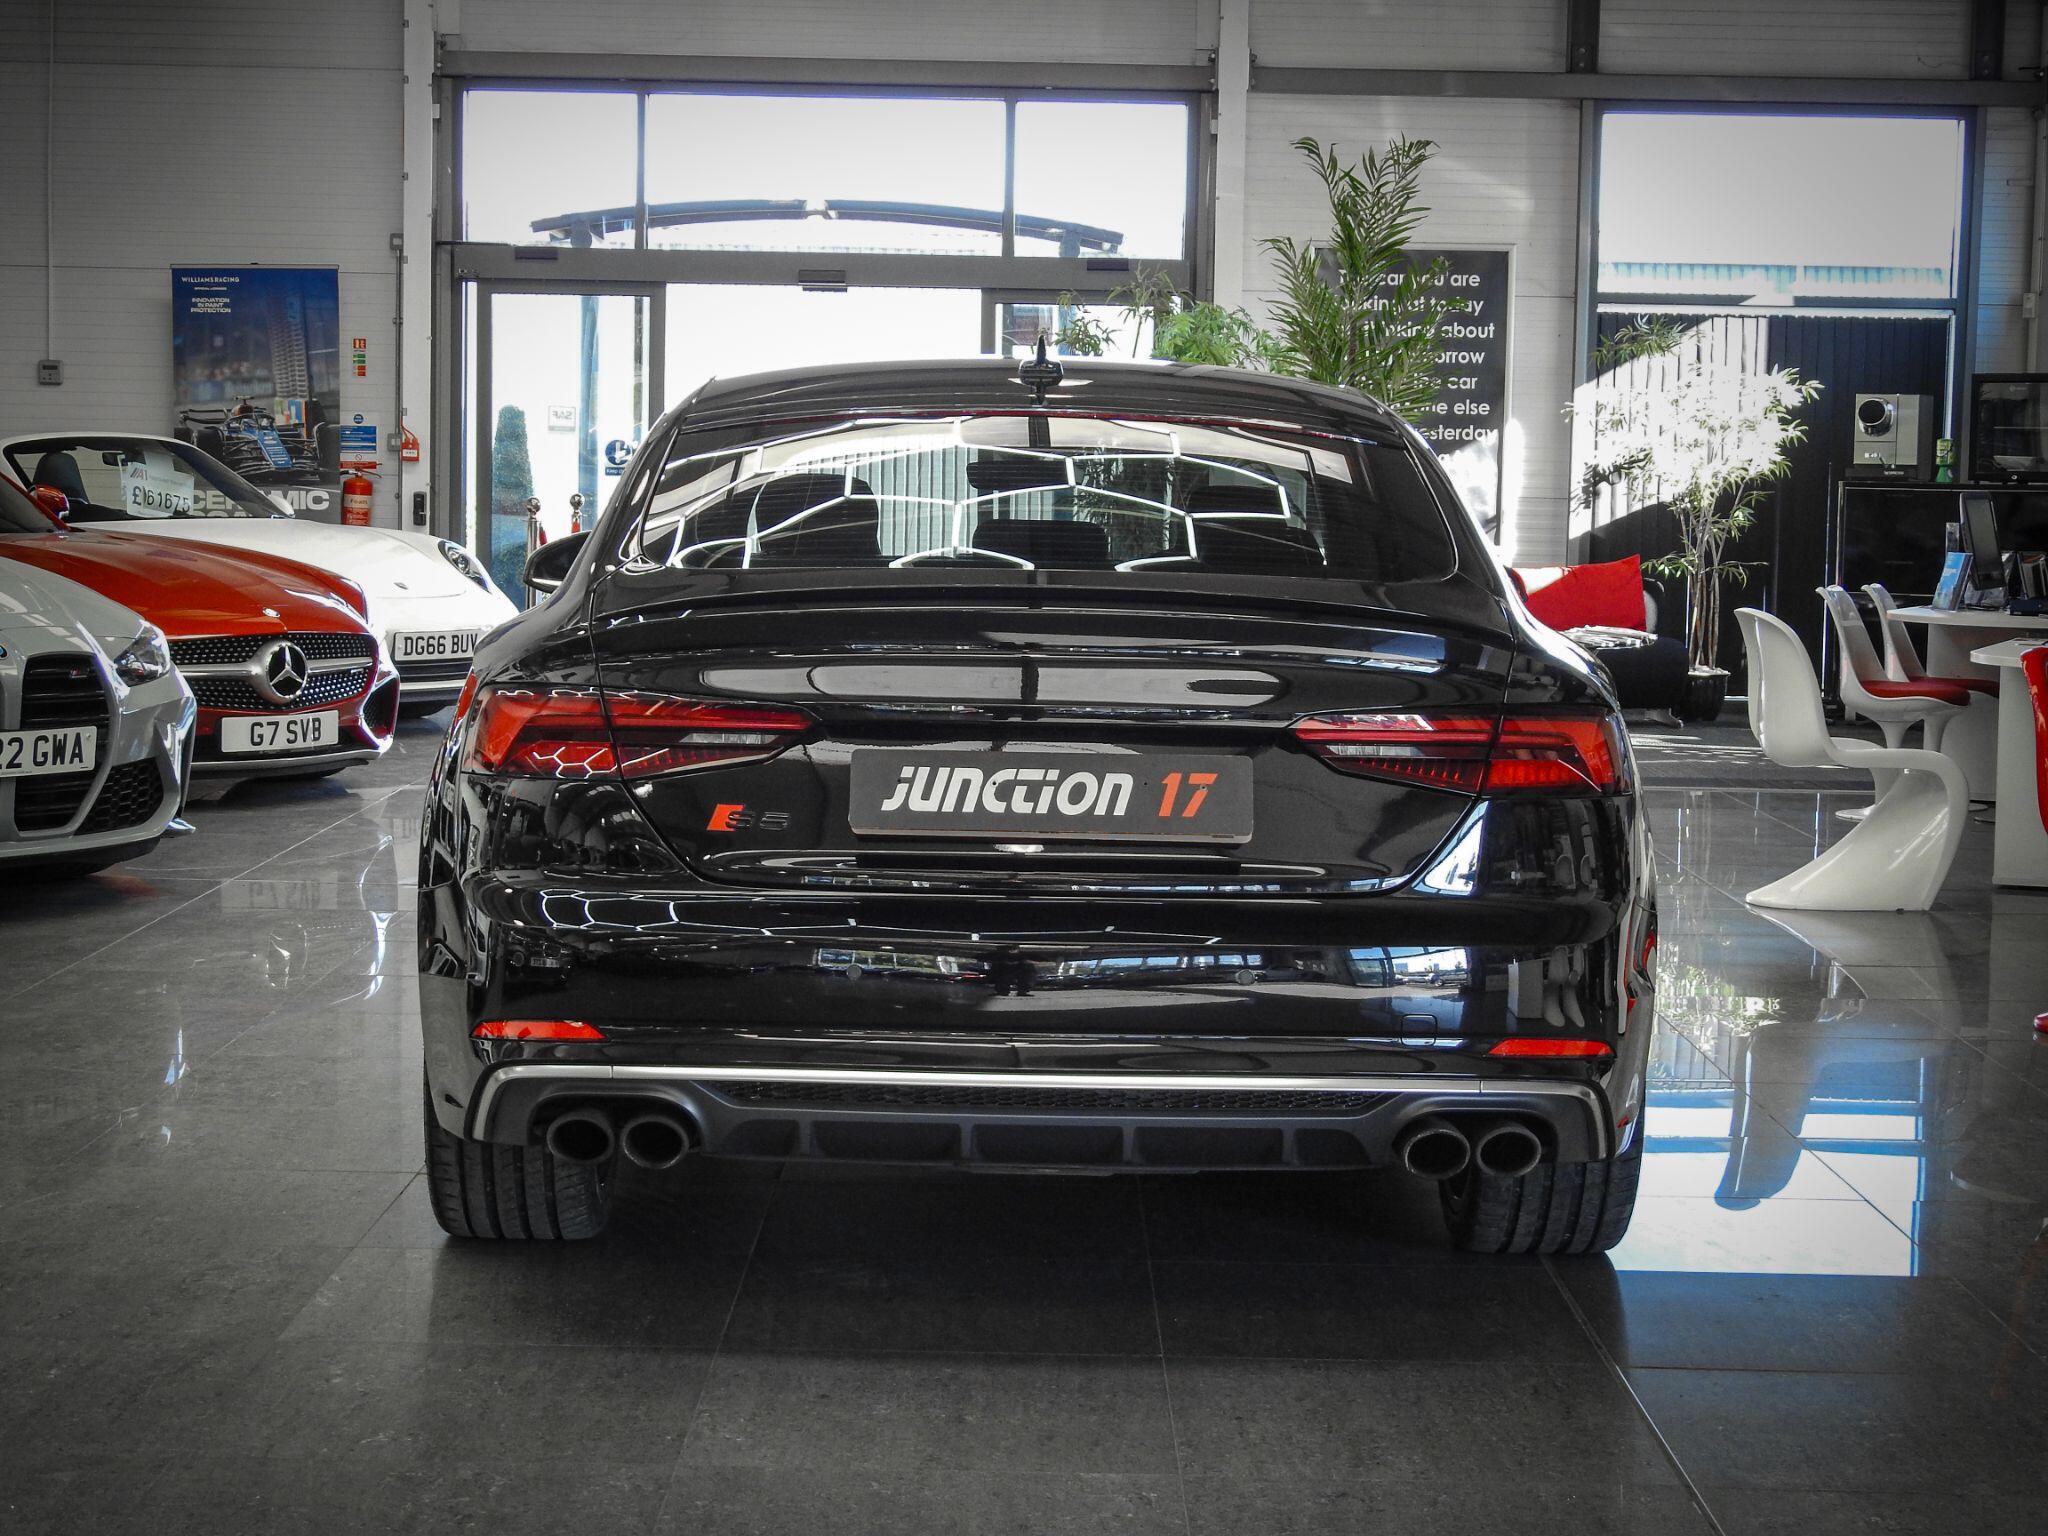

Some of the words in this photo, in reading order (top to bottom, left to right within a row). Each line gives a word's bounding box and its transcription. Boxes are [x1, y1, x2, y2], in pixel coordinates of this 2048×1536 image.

[1450, 273, 1481, 287] are
[1441, 321, 1495, 339] about
[1447, 376, 1478, 389] car
[1453, 399, 1491, 415] else
[1413, 424, 1498, 446] esterday
[193, 490, 330, 511] CEMIC
[403, 635, 447, 656] DG66
[250, 720, 280, 747] G7
[286, 717, 322, 744] SVB
[0, 736, 24, 770] 2
[32, 732, 84, 767] GWA
[1158, 772, 1218, 817] 17
[724, 810, 790, 831] S5
